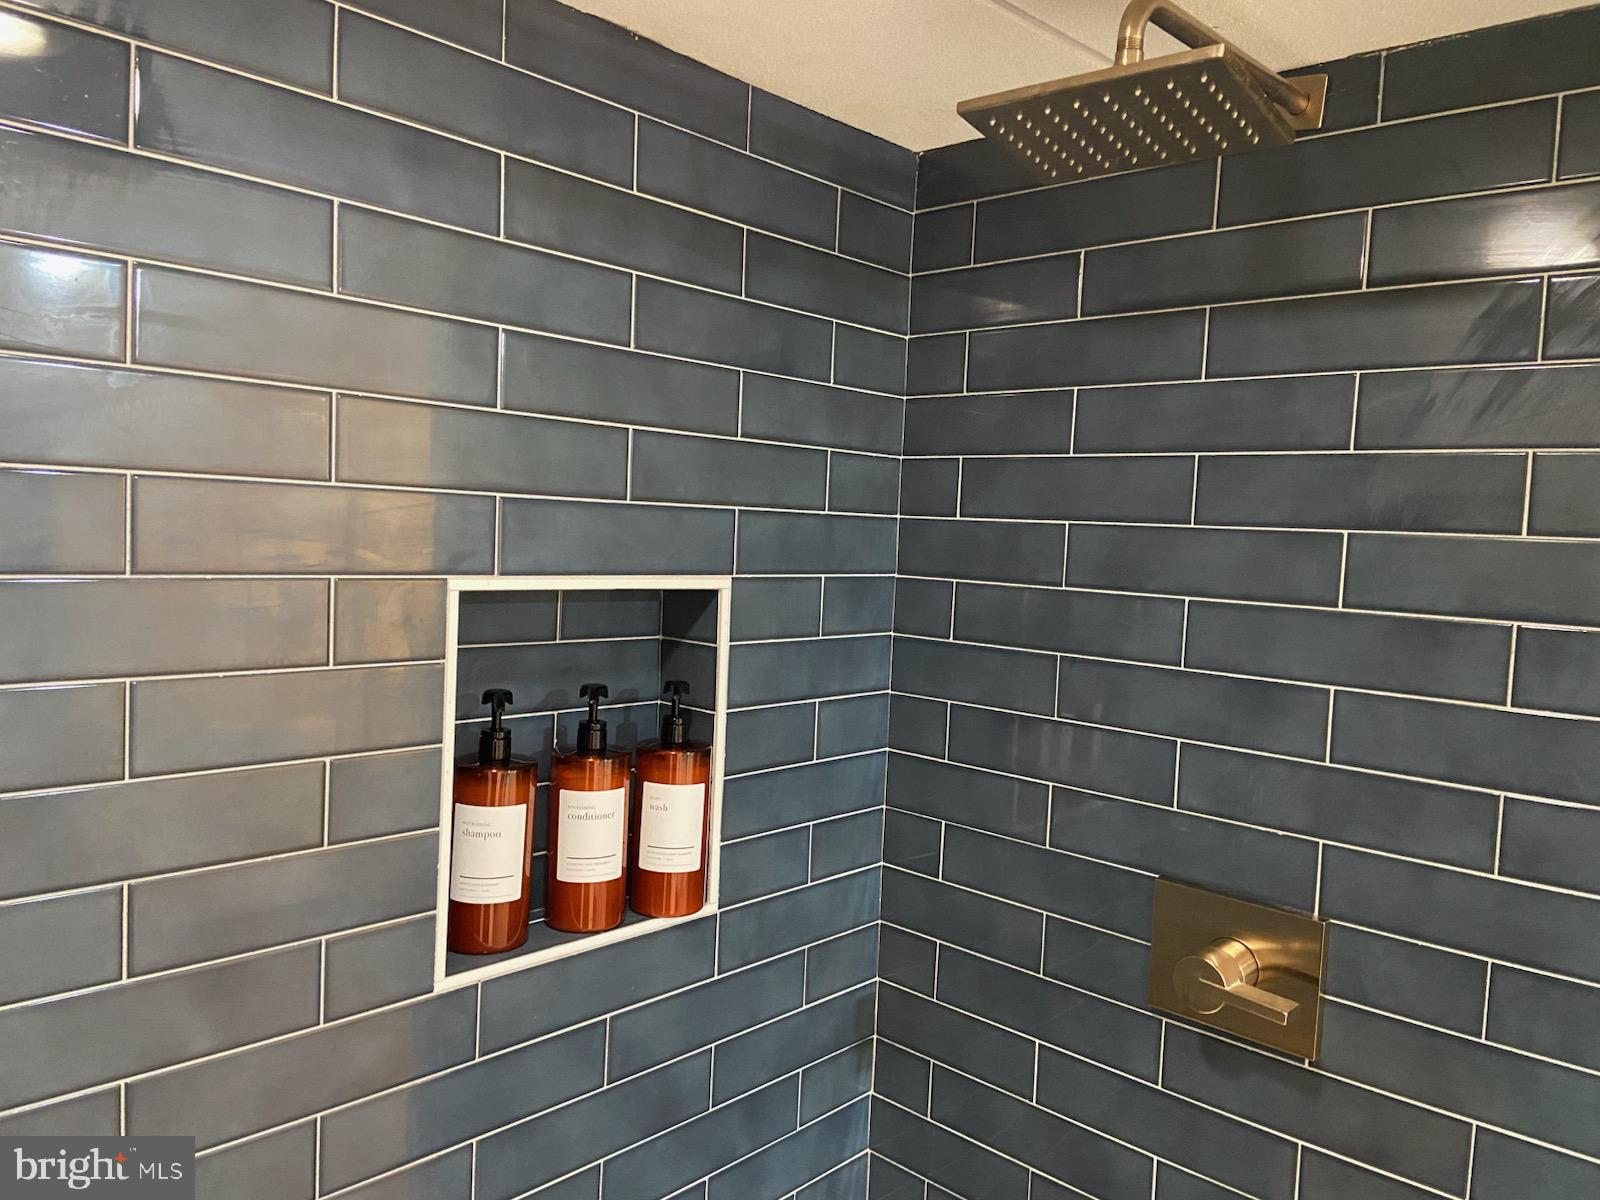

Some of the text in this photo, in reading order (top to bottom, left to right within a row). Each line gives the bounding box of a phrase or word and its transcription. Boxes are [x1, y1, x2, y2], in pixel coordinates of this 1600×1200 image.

[649, 803, 668, 812] wash
[567, 812, 615, 821] conditioner
[462, 828, 502, 840] shampoo
